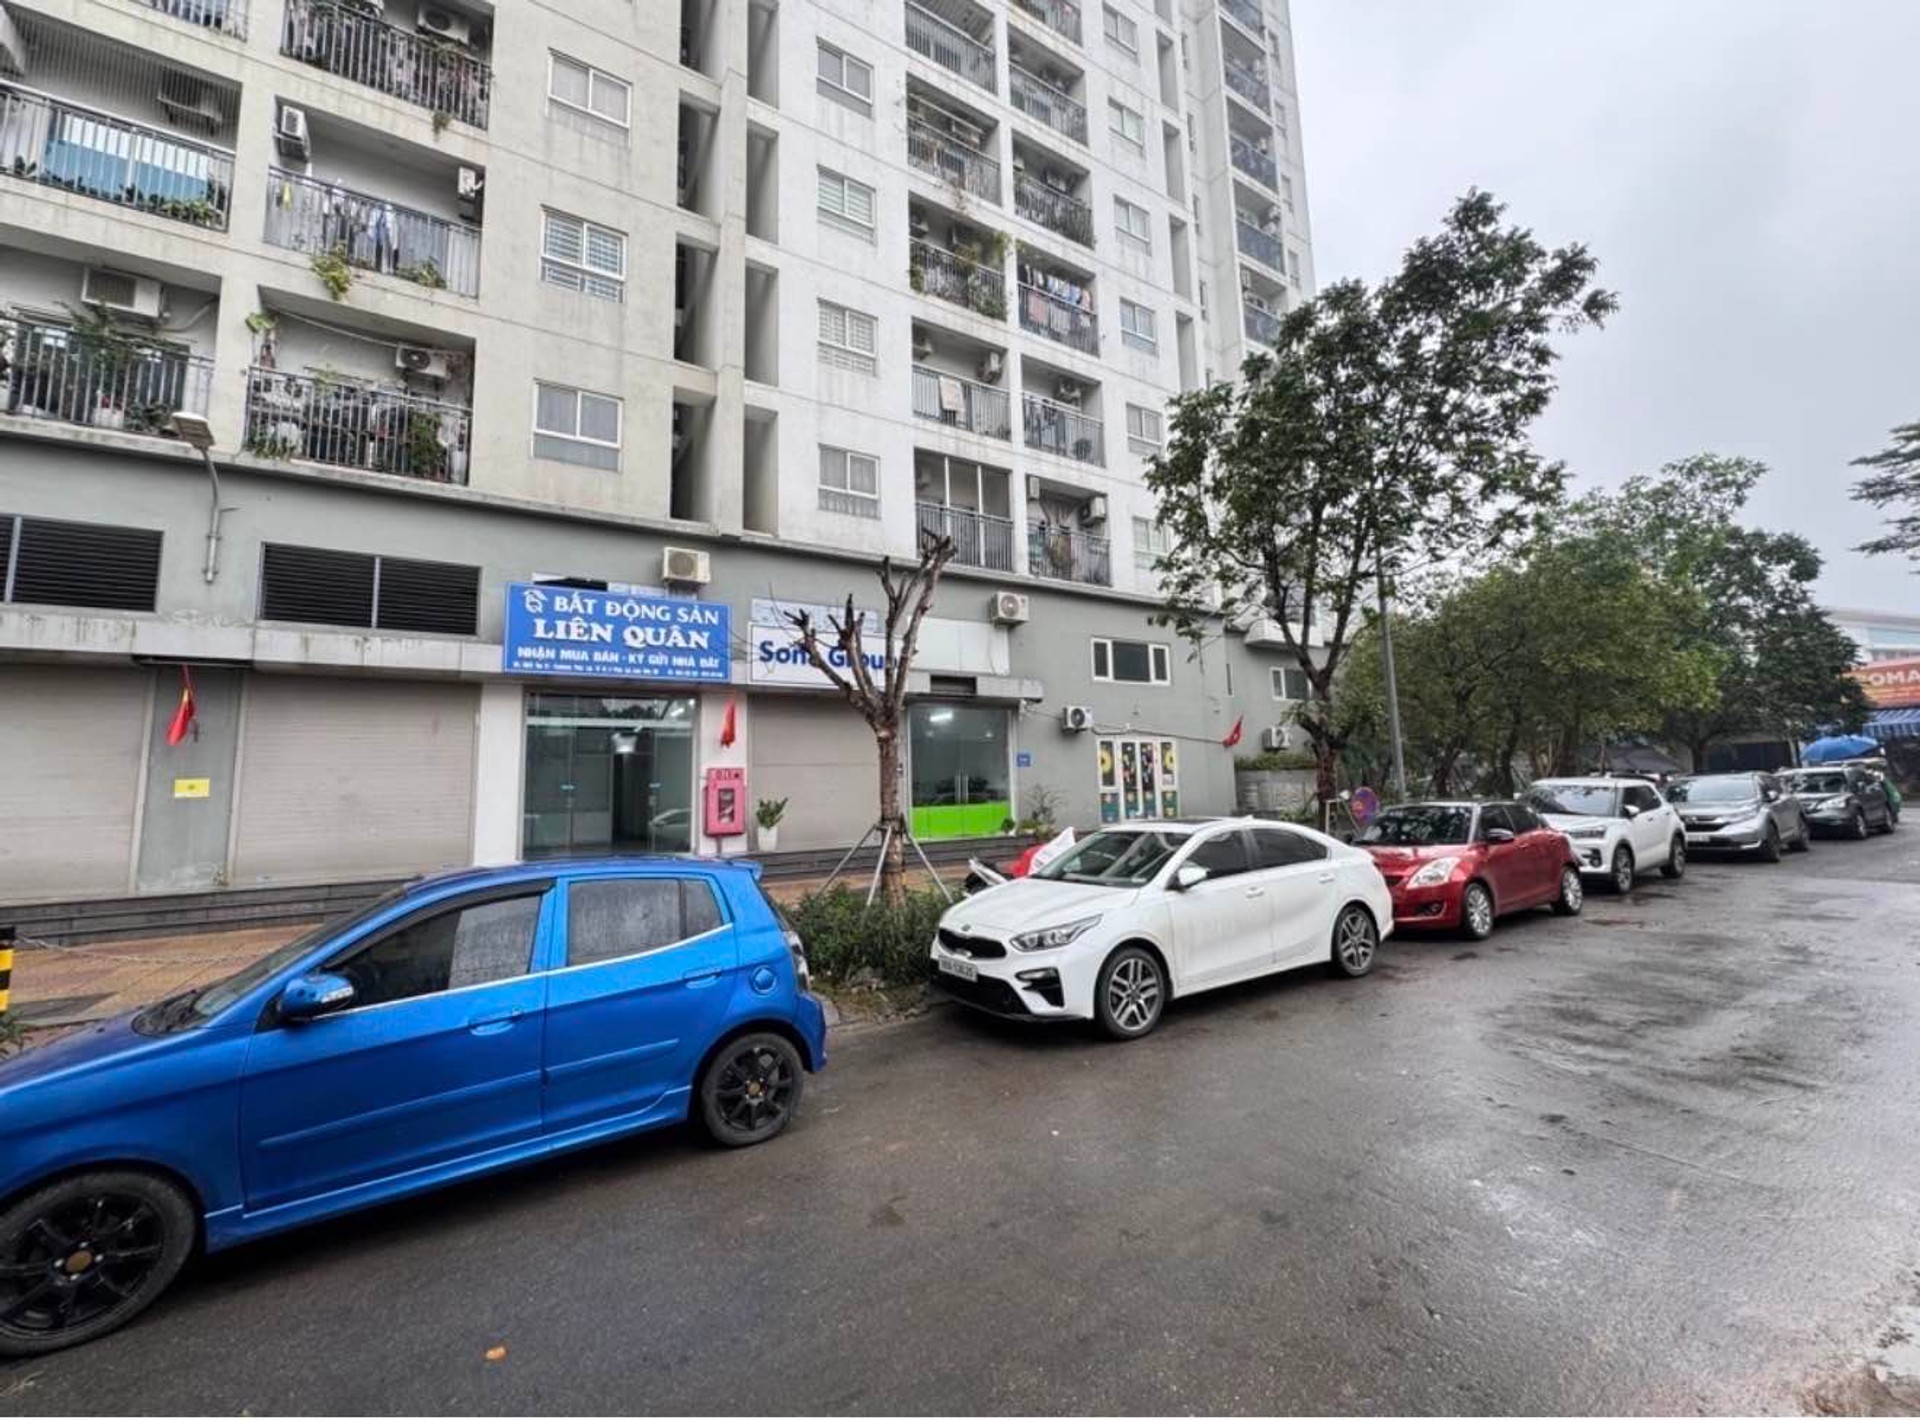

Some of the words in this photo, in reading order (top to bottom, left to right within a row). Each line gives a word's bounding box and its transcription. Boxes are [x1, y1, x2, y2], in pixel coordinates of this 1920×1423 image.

[606, 599, 670, 622] ĐỘNG
[677, 605, 719, 625] SẢN
[534, 616, 614, 642] LIÊN
[623, 625, 710, 650] QUÂN
